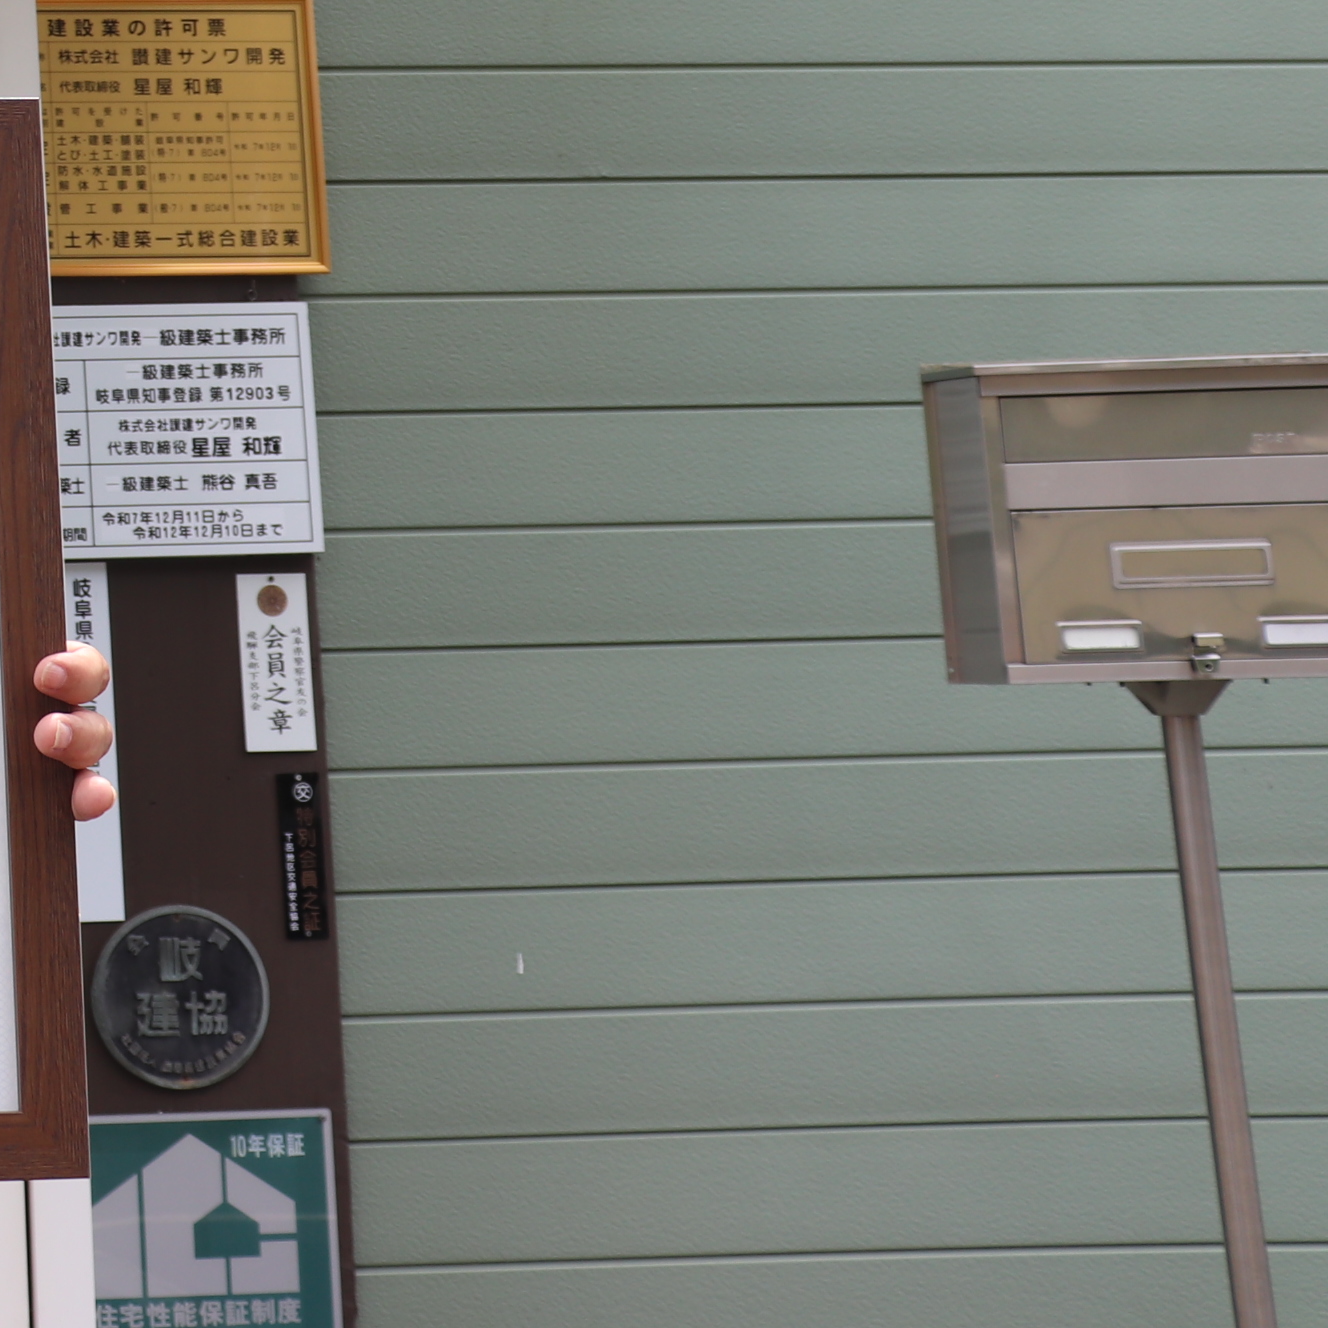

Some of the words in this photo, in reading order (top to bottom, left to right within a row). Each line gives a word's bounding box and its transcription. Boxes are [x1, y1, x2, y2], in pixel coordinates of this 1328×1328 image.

[47, 18, 226, 37] 建設業の許可票
[58, 49, 120, 65] 株式会社
[132, 47, 286, 66] 讃建サンワ開発
[59, 80, 121, 94] 代表取締役
[134, 79, 173, 96] 星屋
[184, 78, 223, 95] 和輝
[127, 362, 264, 380] 一級建築士事務所
[96, 388, 204, 405] 岐阜県知事登録
[64, 429, 82, 447] 者
[107, 440, 188, 456] 代表取締役
[191, 437, 232, 458] 星屋
[242, 435, 282, 457] 和輝
[106, 476, 189, 492] 一級建築士
[201, 474, 236, 491] 熊谷
[244, 473, 279, 490] 真吾
[102, 510, 245, 527] 令和7年12月11日から
[132, 523, 284, 540] 令和12年12月10日まで
[262, 624, 293, 735] 会員之章
[230, 1133, 305, 1158] 10年保証
[95, 1298, 302, 1328] 住宅性能保証制度
